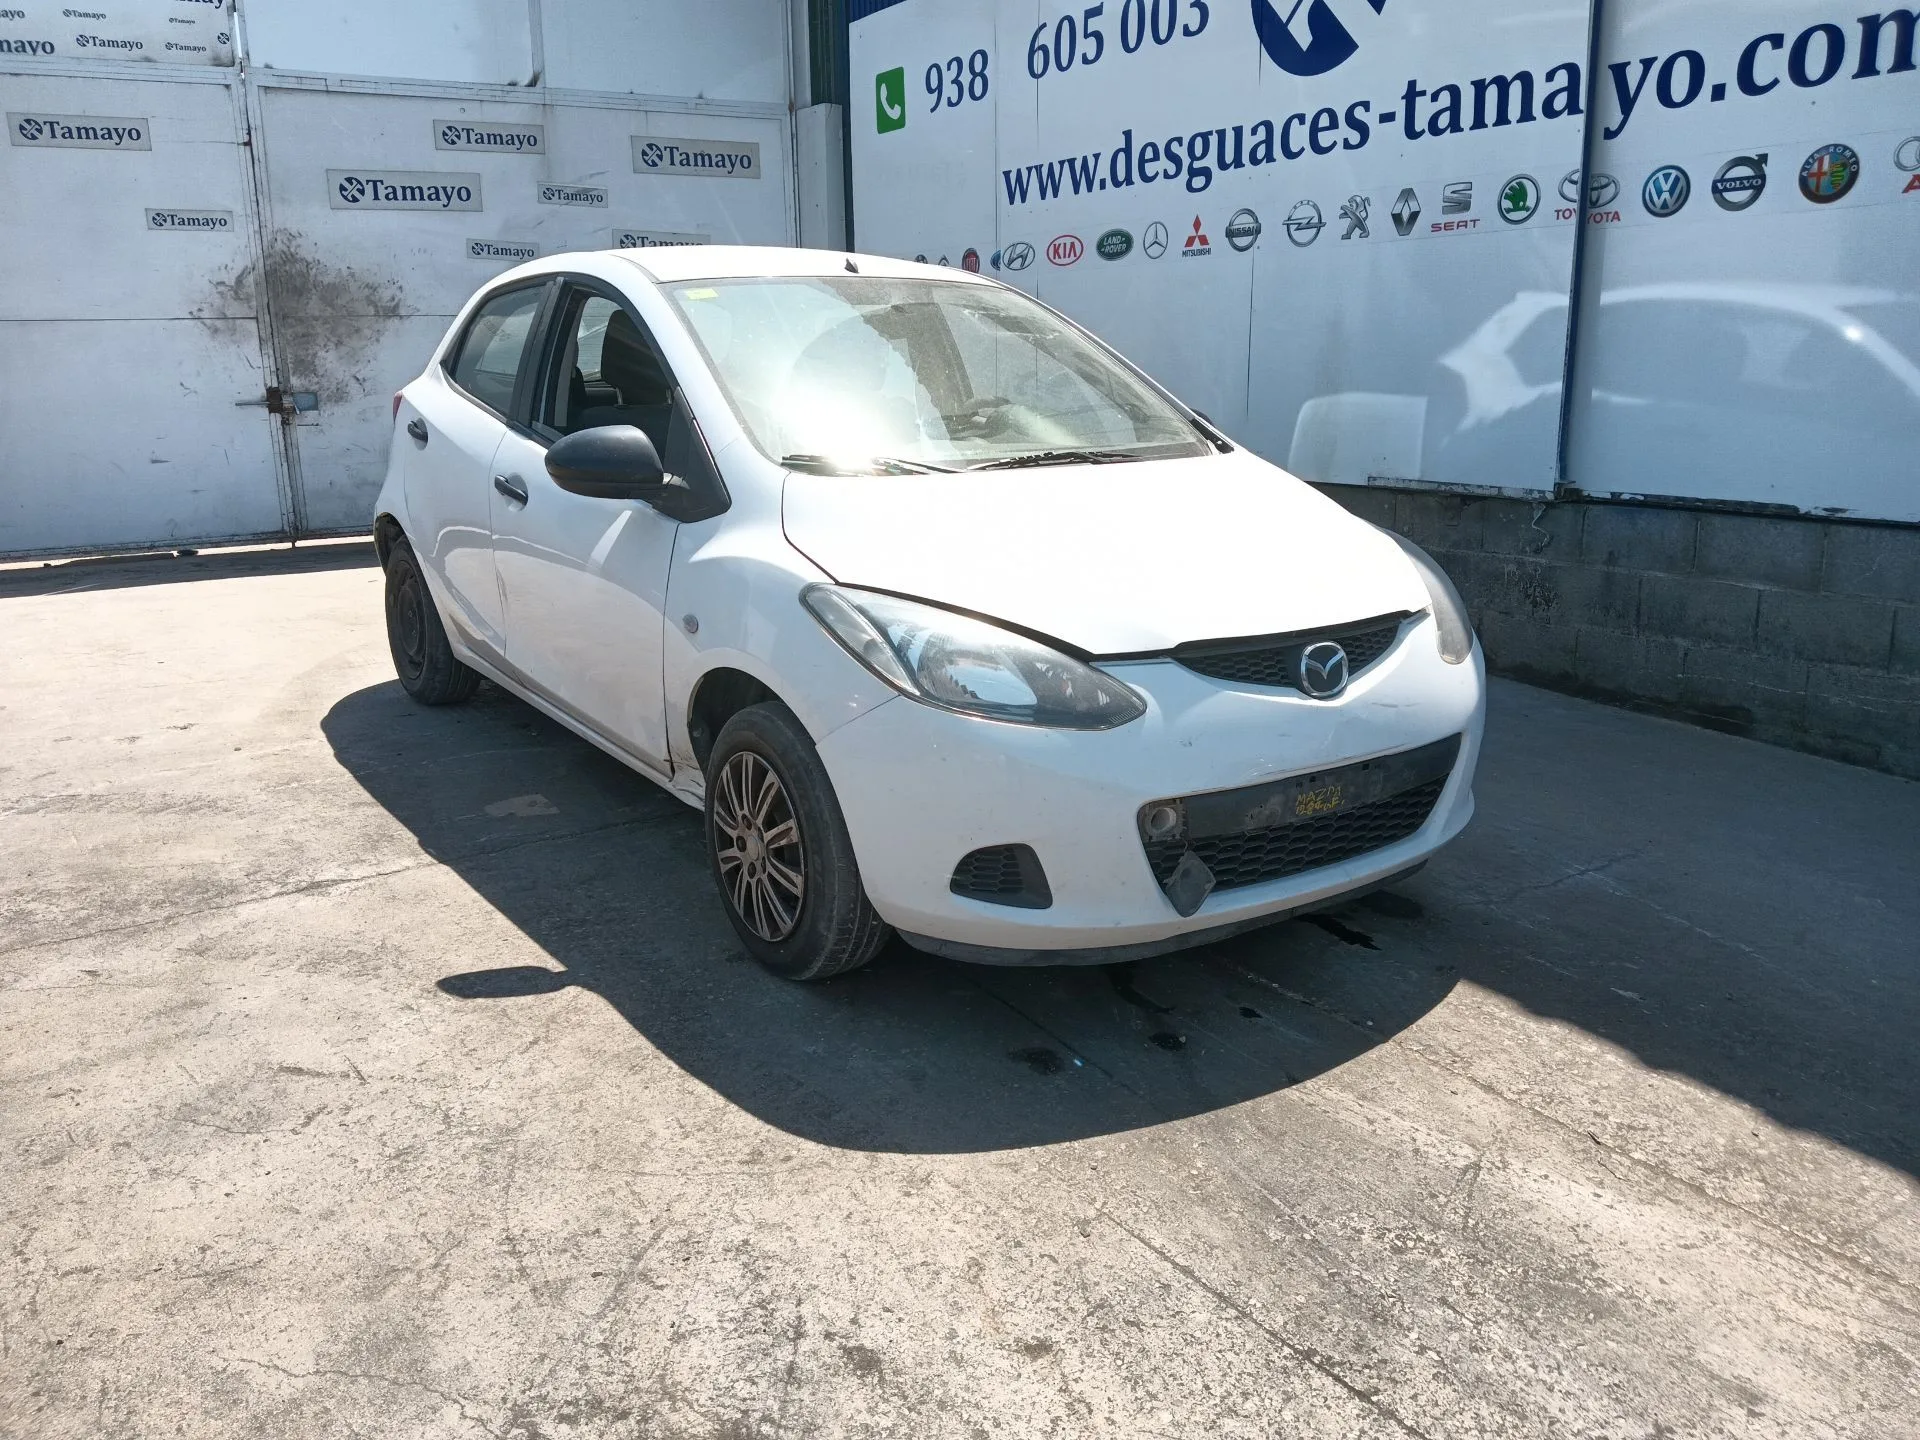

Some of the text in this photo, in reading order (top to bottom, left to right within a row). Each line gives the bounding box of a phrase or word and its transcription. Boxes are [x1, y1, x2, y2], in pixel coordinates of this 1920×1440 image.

[0, 9, 25, 20] ayo
[71, 9, 107, 20] Tamayo
[89, 35, 143, 51] Tamayo
[173, 43, 207, 53] Tamayo
[925, 0, 1210, 113] 938 605 003
[43, 120, 142, 145] Tamayo
[461, 127, 538, 150] Tamayo
[664, 146, 752, 174] Tamayo
[1801, 145, 1858, 177] ALFA ROMEO
[1716, 178, 1762, 190] VOLVO
[365, 179, 472, 208] Tamayo
[555, 189, 604, 205] Tamayo
[167, 213, 228, 230] Tamayo
[1431, 219, 1480, 233] SEAT
[1229, 226, 1257, 236] NISSAN
[1103, 236, 1122, 246] LAND
[1104, 244, 1127, 253] ROVER
[483, 243, 535, 260] Tamayo
[1052, 241, 1077, 260] KIA
[1182, 247, 1211, 257] MITSUBISHI
